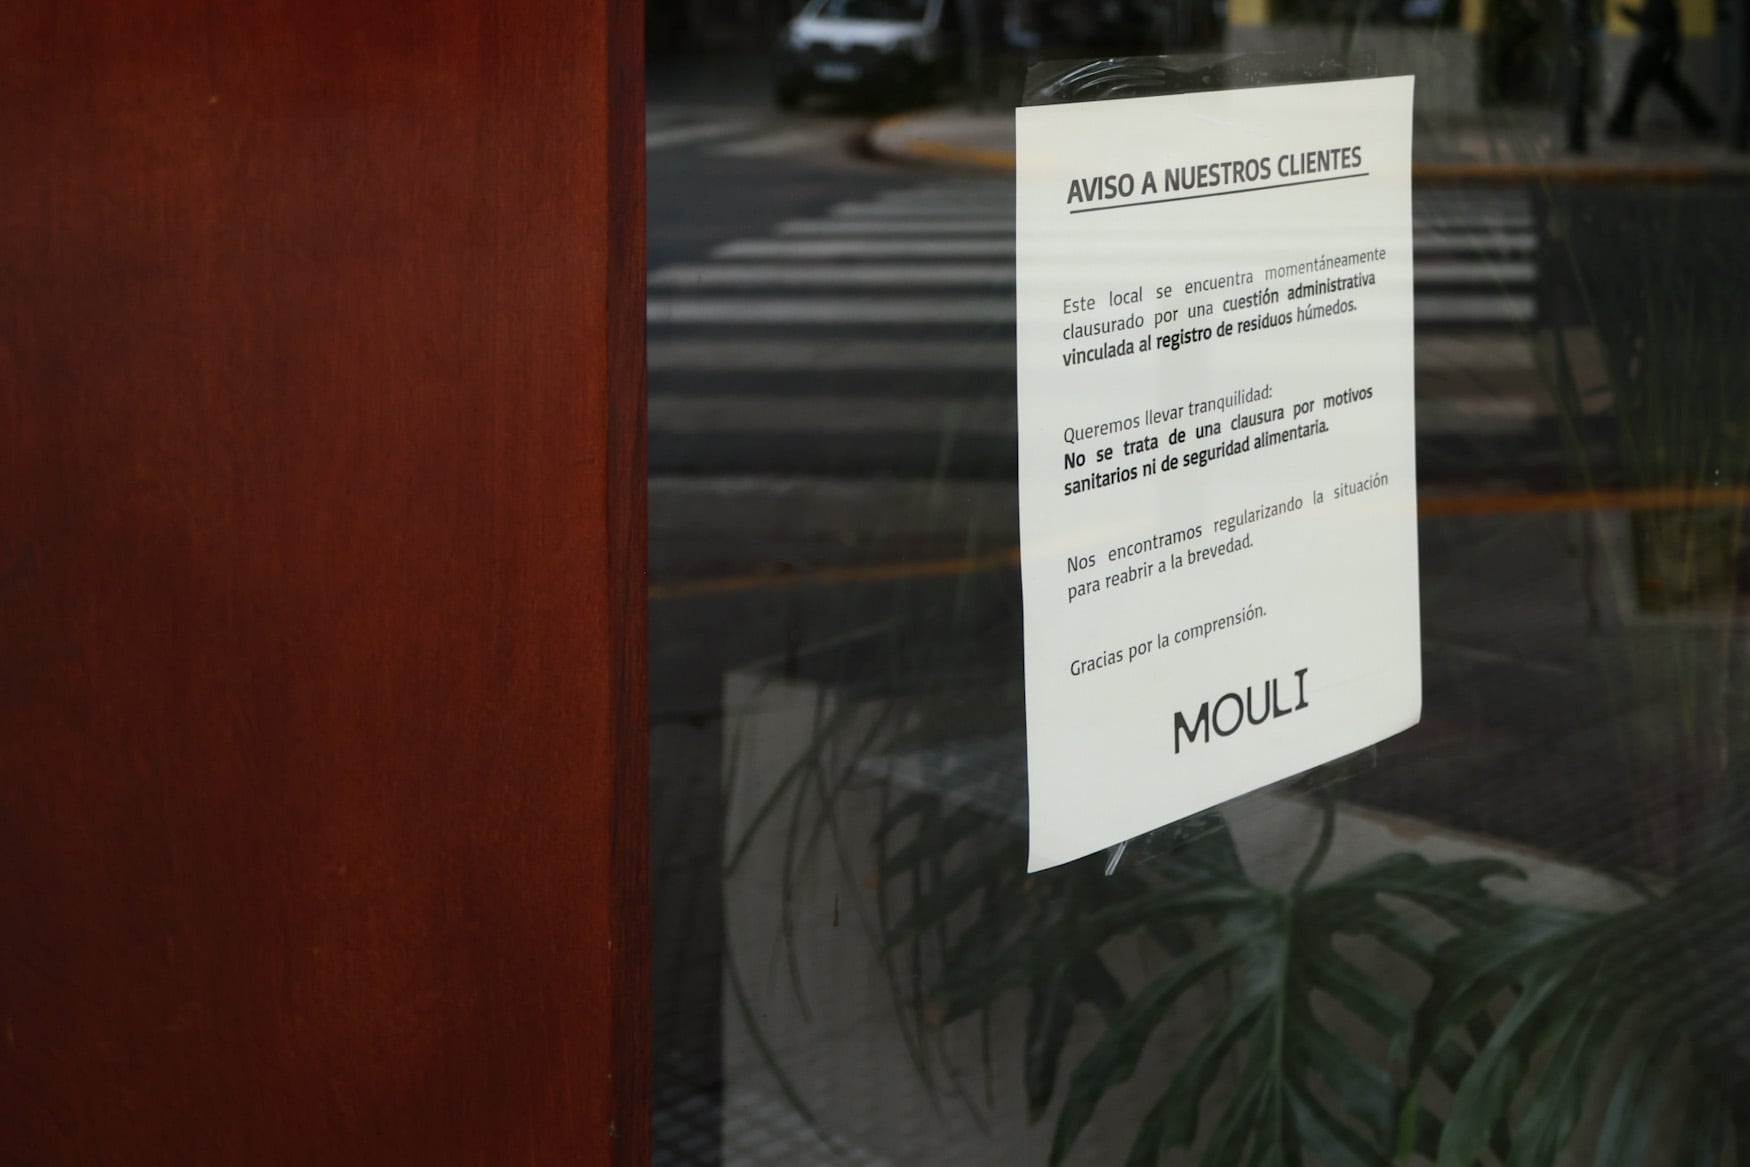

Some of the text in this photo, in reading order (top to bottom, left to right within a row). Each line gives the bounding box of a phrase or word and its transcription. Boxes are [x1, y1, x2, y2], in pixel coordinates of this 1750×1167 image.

[1066, 145, 1363, 204] AVISO A NUESTROS CLIENTES
[1062, 270, 1376, 342] clausurado por una cuestión administrativa
[1063, 246, 1387, 315] Este local se encuentra momentáneamente
[1062, 298, 1358, 368] vinculada al registro de residuos húmedos.
[1064, 383, 1274, 445] Queremos llevar tranquilidad:
[1064, 385, 1374, 471] No se trata de una clausura por motivos
[1064, 419, 1330, 498] sanitarios ni de seguridad alimentaria.
[1067, 472, 1390, 574] Nos encontramos regularizando la situación
[1067, 534, 1255, 604] para reabrir a la brevedad.
[1070, 603, 1268, 678] Gracias por la comprensión.
[1174, 667, 1309, 754] MOULI
